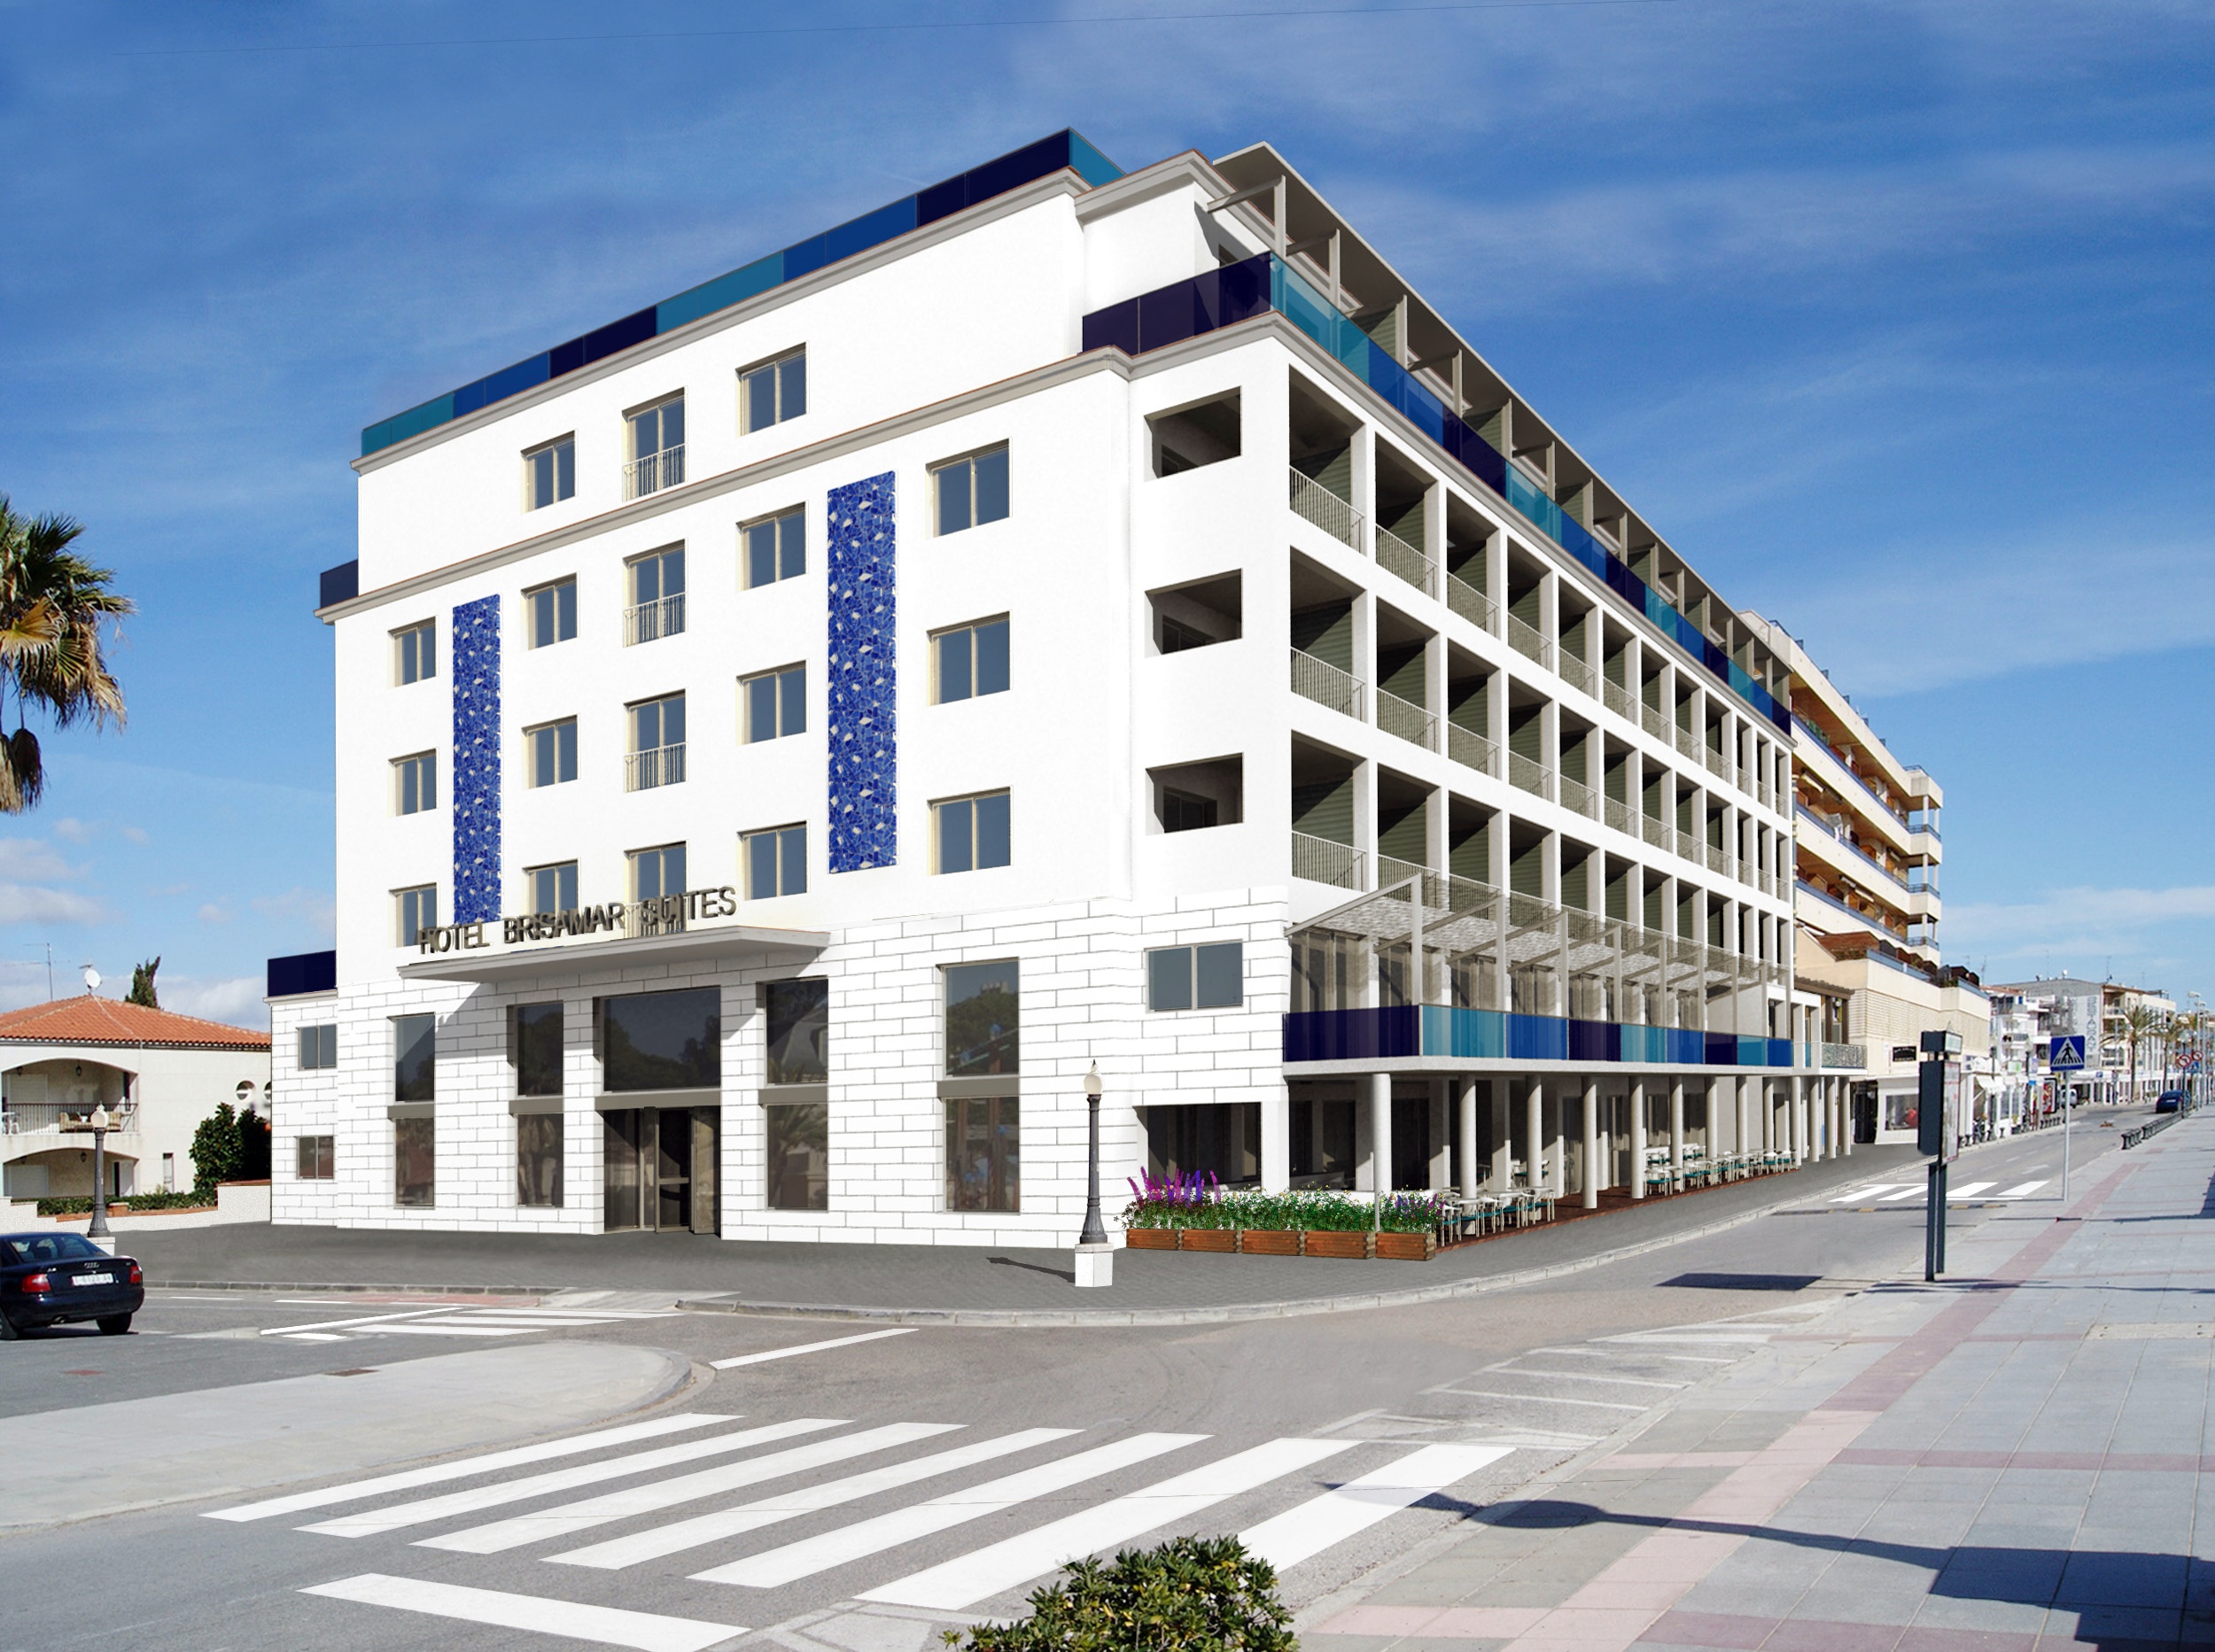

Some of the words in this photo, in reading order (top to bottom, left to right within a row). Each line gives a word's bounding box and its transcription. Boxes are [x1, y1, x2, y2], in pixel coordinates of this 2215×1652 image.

[419, 921, 490, 954] HOTEL
[502, 902, 626, 943] BRISAMAR
[640, 886, 737, 925] SUITES
